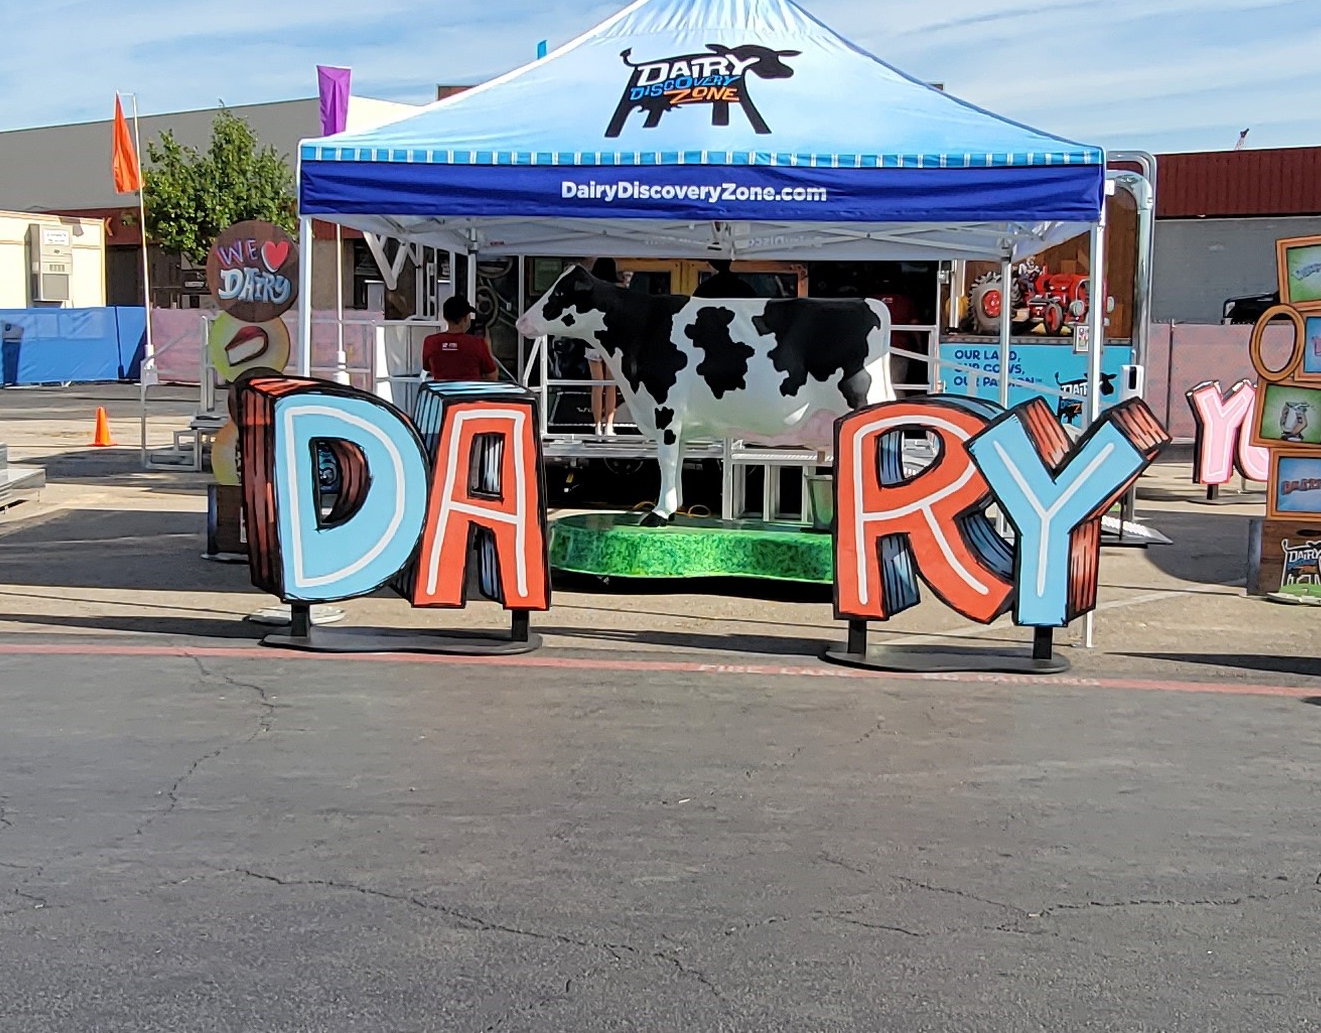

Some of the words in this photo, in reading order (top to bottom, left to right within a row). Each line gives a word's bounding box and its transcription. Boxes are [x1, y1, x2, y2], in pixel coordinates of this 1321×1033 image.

[664, 87, 740, 105] ZONE
[561, 180, 827, 204] DairyDiscoveryZone.com
[216, 237, 259, 268] WE
[954, 350, 981, 361] OUR
[983, 350, 1022, 363] LAD,
